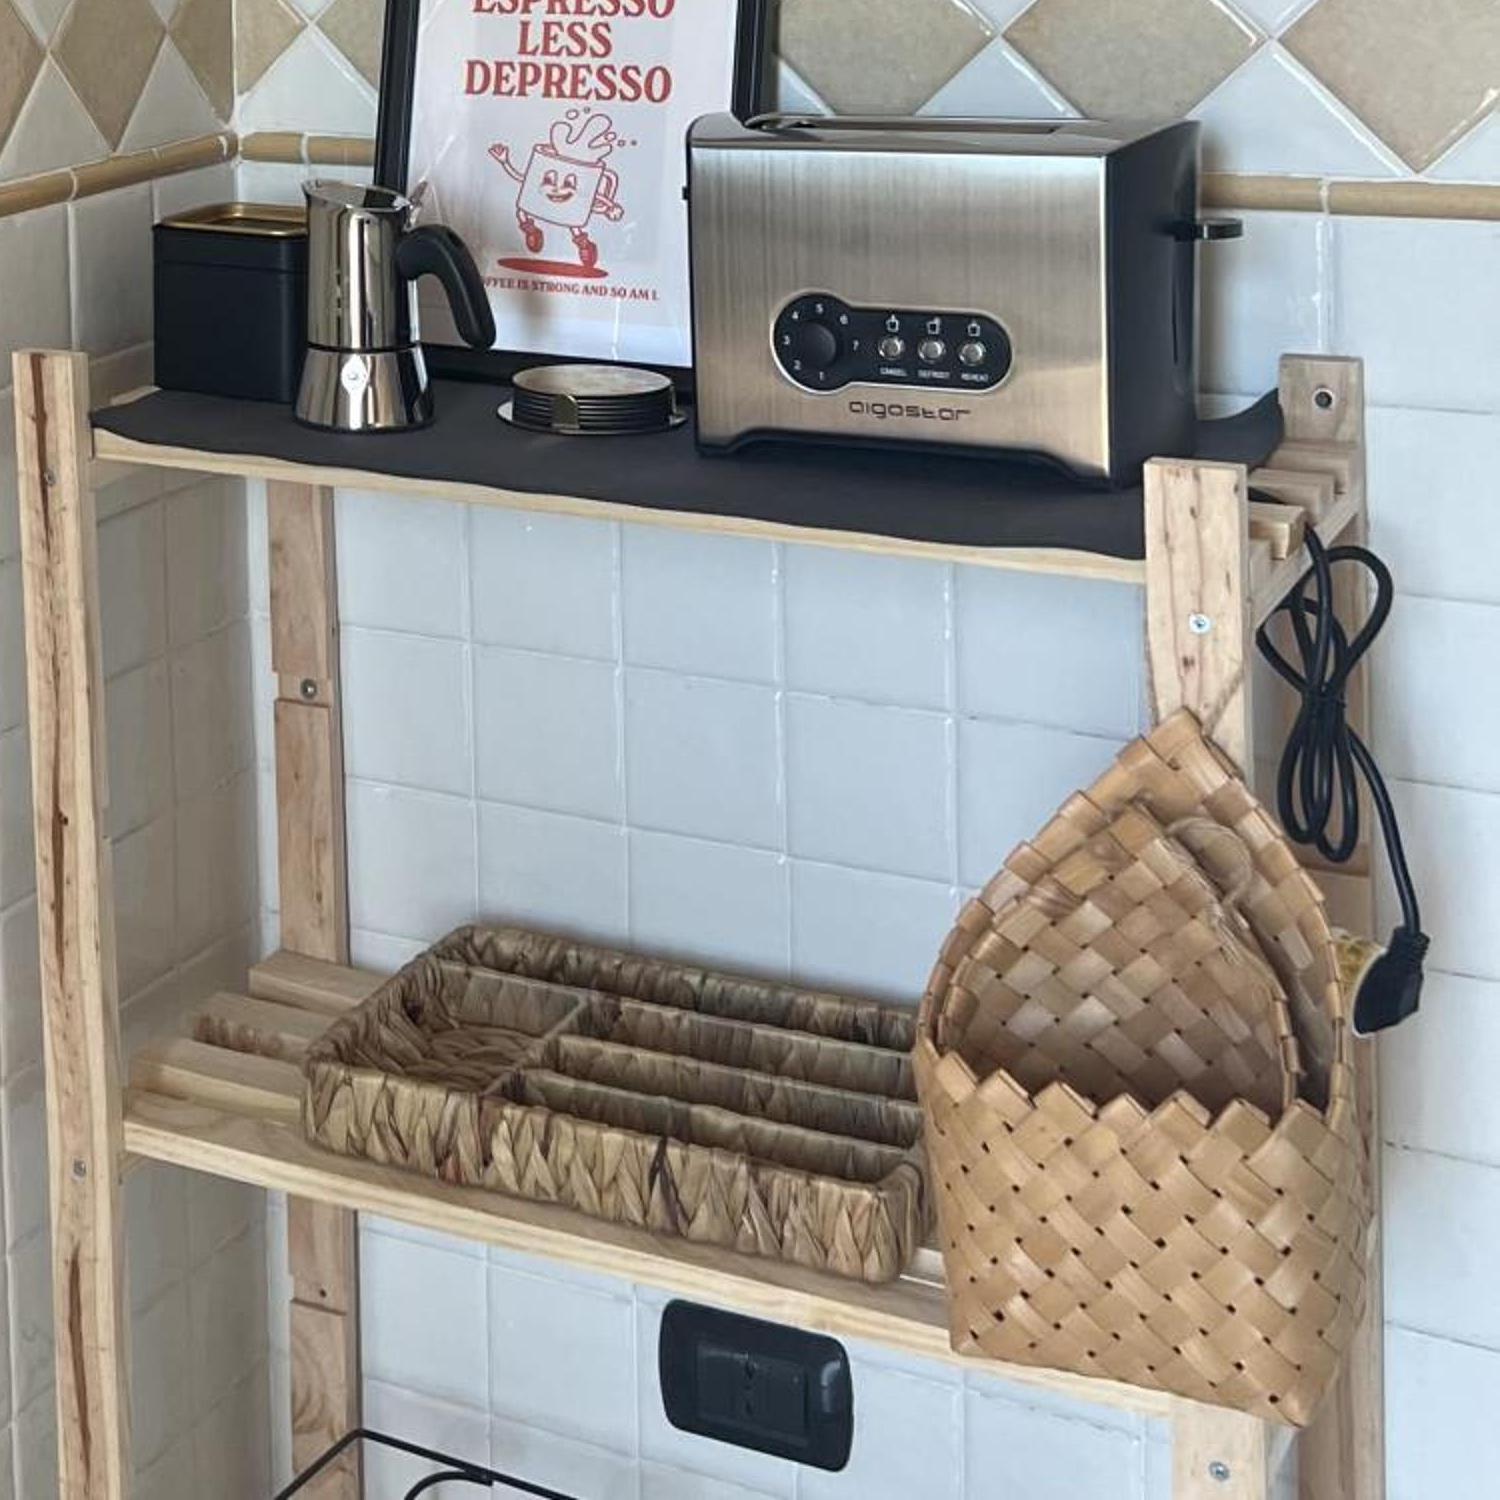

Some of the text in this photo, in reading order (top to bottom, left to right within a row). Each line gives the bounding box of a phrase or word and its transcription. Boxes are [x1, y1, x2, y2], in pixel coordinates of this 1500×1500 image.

[517, 20, 613, 59] LESS
[465, 60, 673, 104] DEPRESSO
[531, 280, 580, 294] STRONG
[582, 284, 608, 297] AND
[610, 286, 627, 299] SO
[629, 288, 649, 301] AM
[849, 400, 971, 421] aigostar
